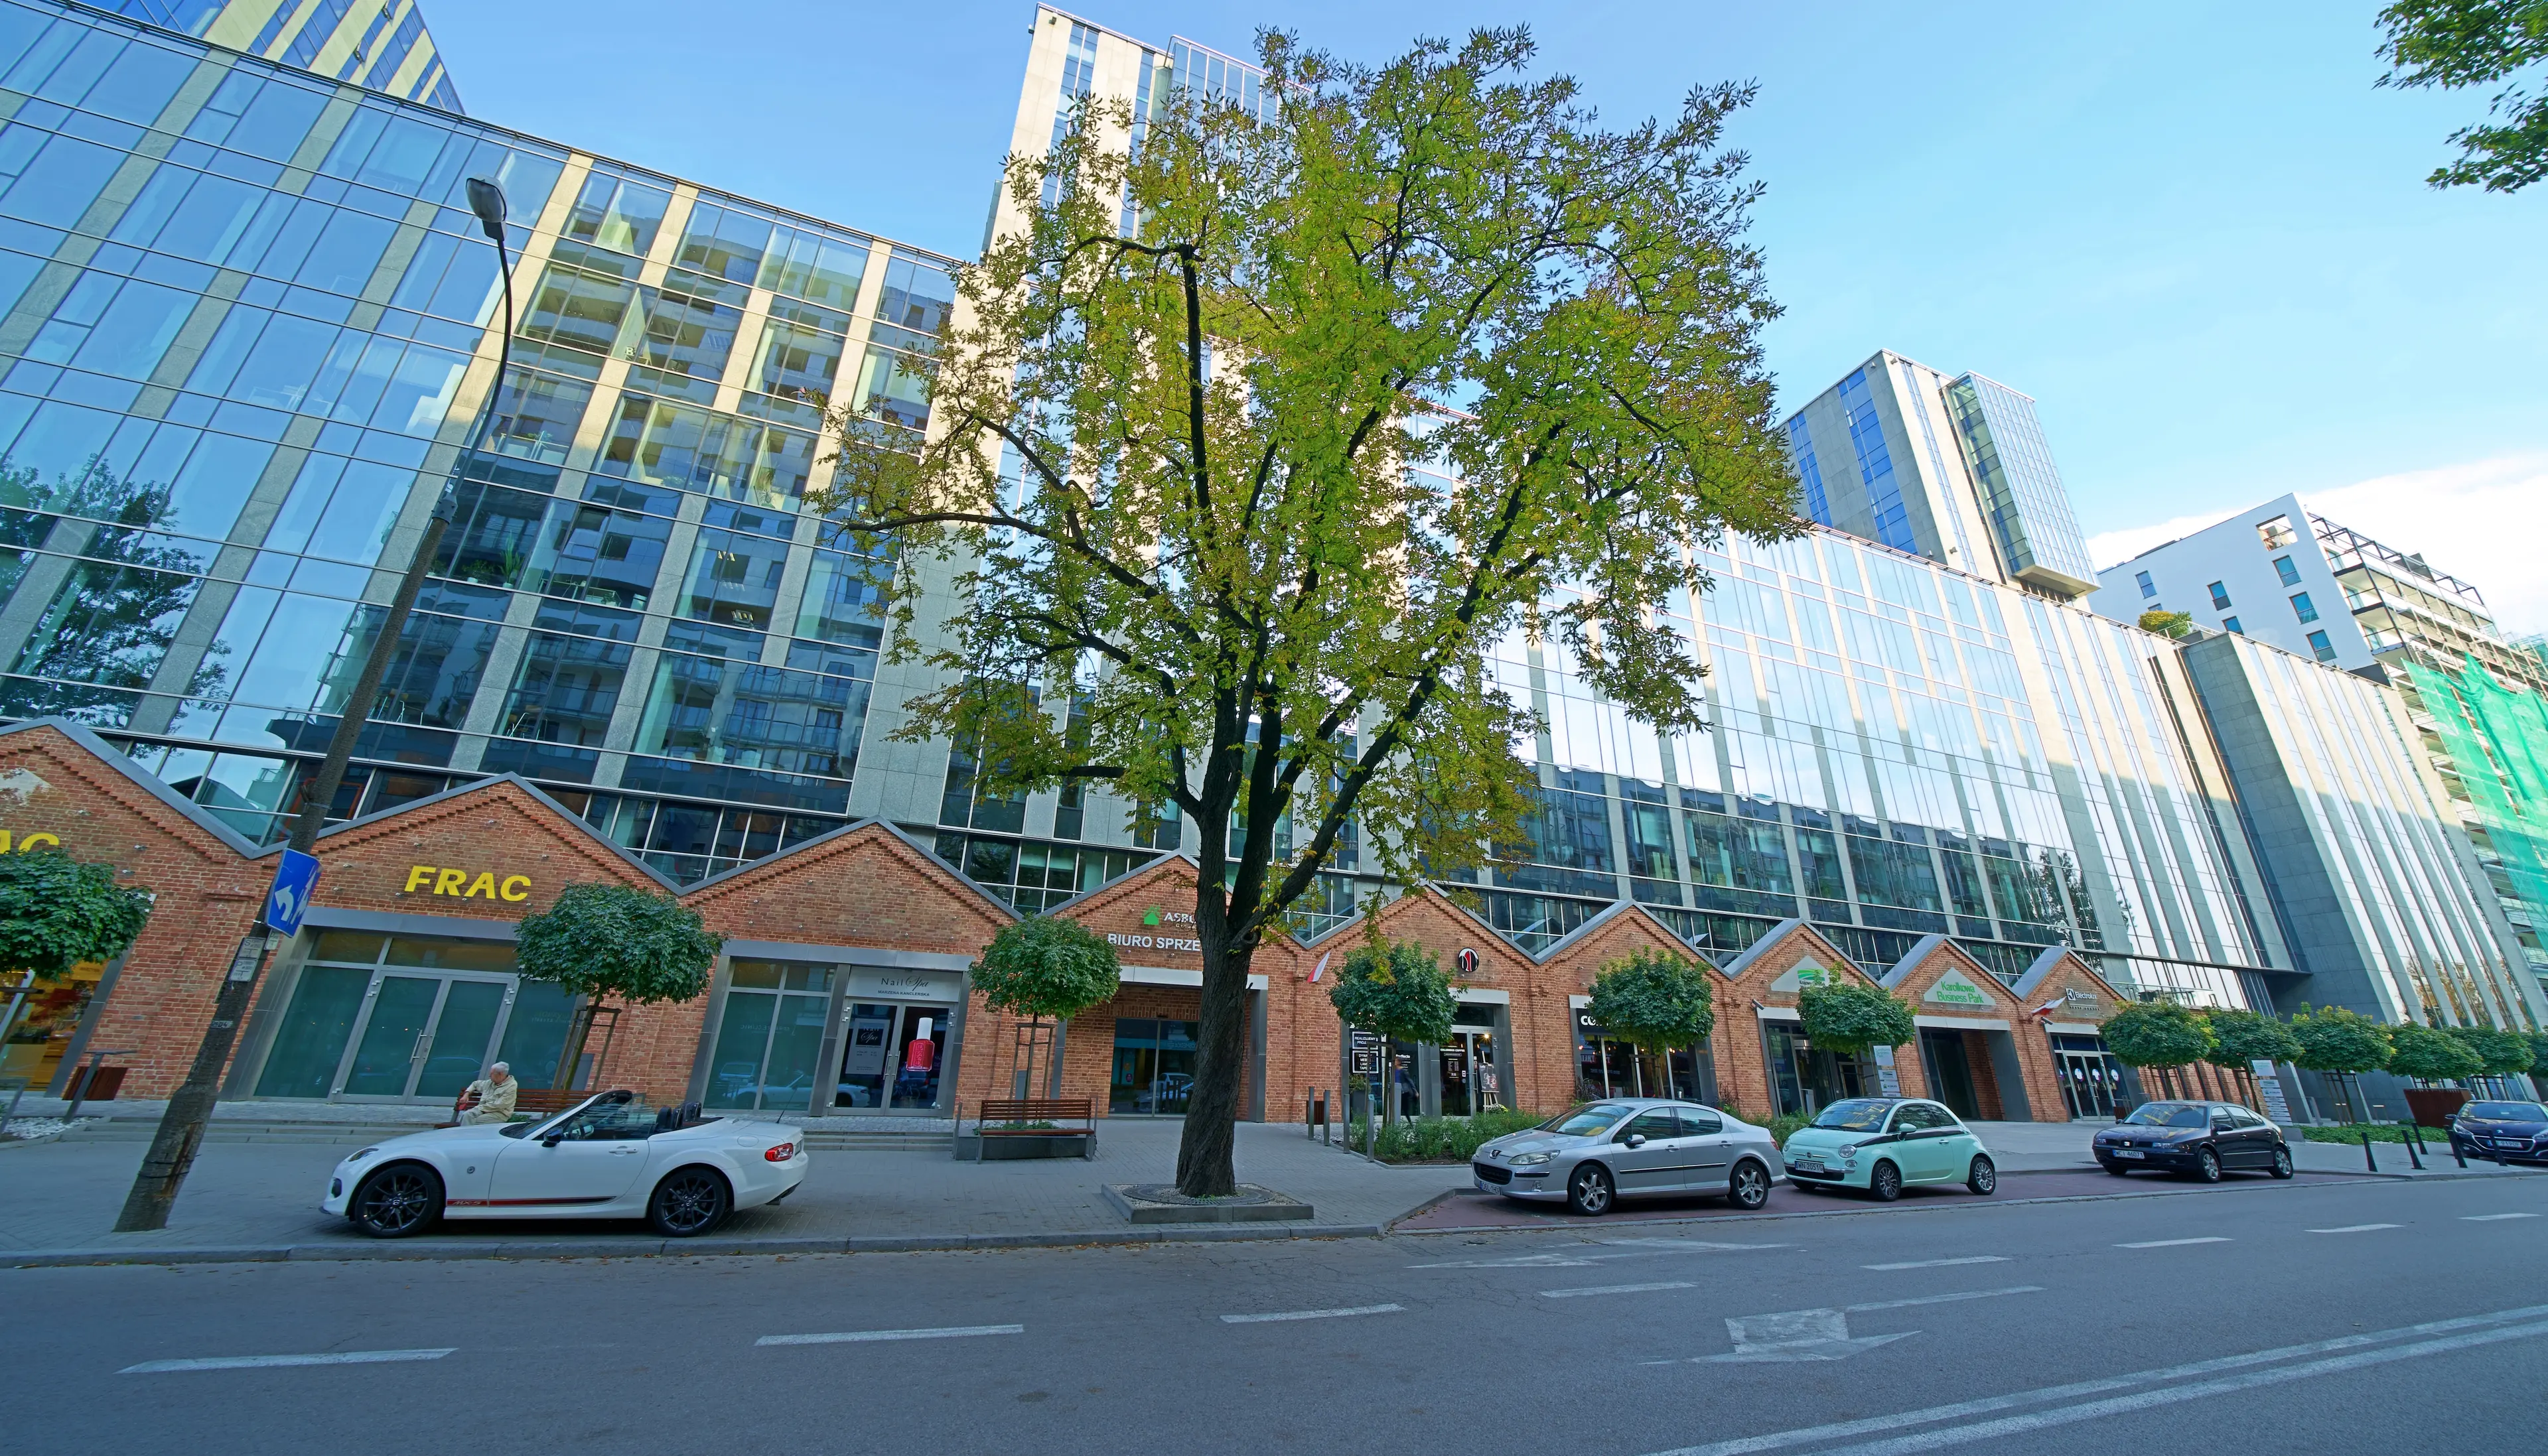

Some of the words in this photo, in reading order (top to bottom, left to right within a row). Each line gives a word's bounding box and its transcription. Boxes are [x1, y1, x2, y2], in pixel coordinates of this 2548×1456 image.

[404, 866, 531, 901] FRAC
[1107, 933, 1153, 948] BIURO
[1156, 937, 1201, 951] SPRZE
[881, 977, 903, 986] Nail
[905, 975, 929, 992] Spa
[1940, 981, 1975, 993] Karolkowa
[1936, 991, 1967, 1003] Business
[1967, 993, 1984, 1004] Park
[2074, 991, 2097, 1000] Electrolux
